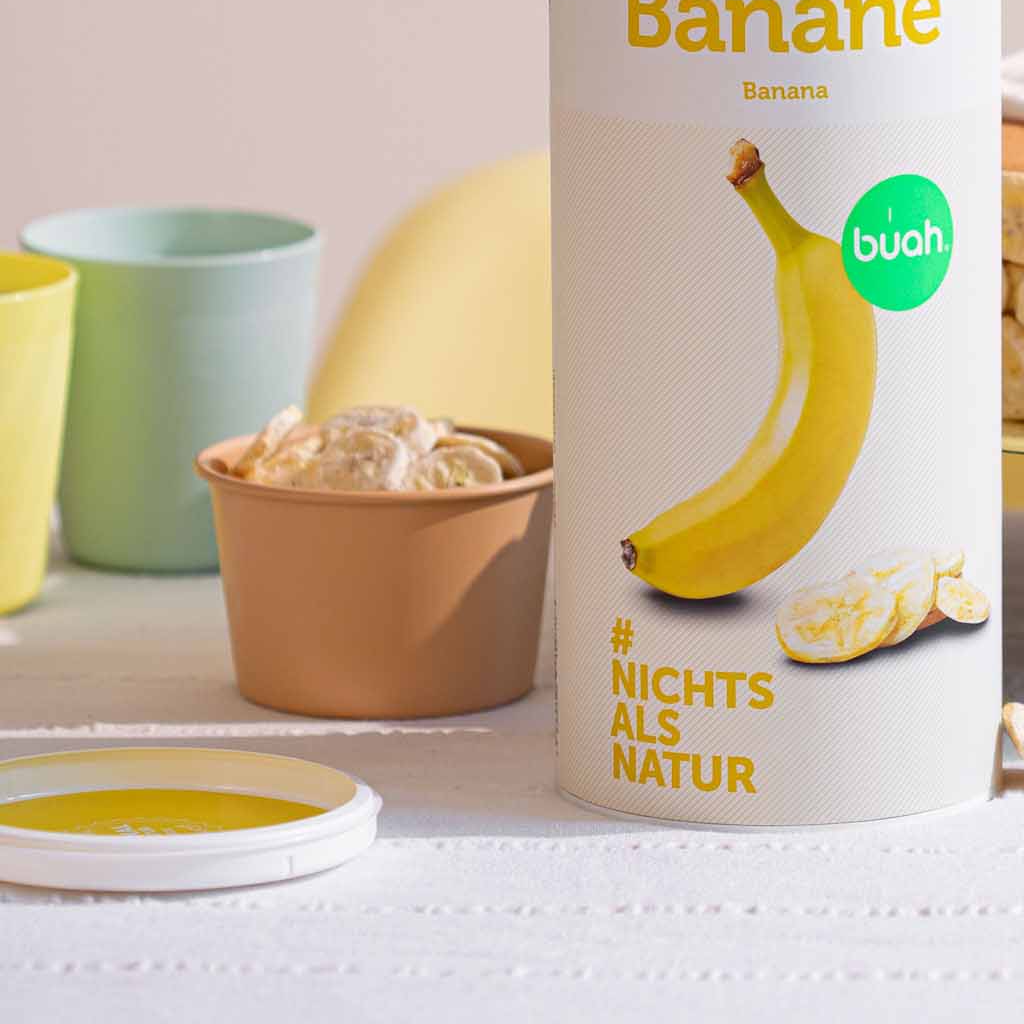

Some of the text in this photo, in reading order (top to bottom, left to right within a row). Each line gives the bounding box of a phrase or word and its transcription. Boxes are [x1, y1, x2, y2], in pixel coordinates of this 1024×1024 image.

[742, 80, 829, 100] Banana
[610, 617, 635, 657] #
[611, 659, 775, 710] NICHTS
[610, 702, 681, 746] ALS
[612, 742, 757, 794] NATUR
